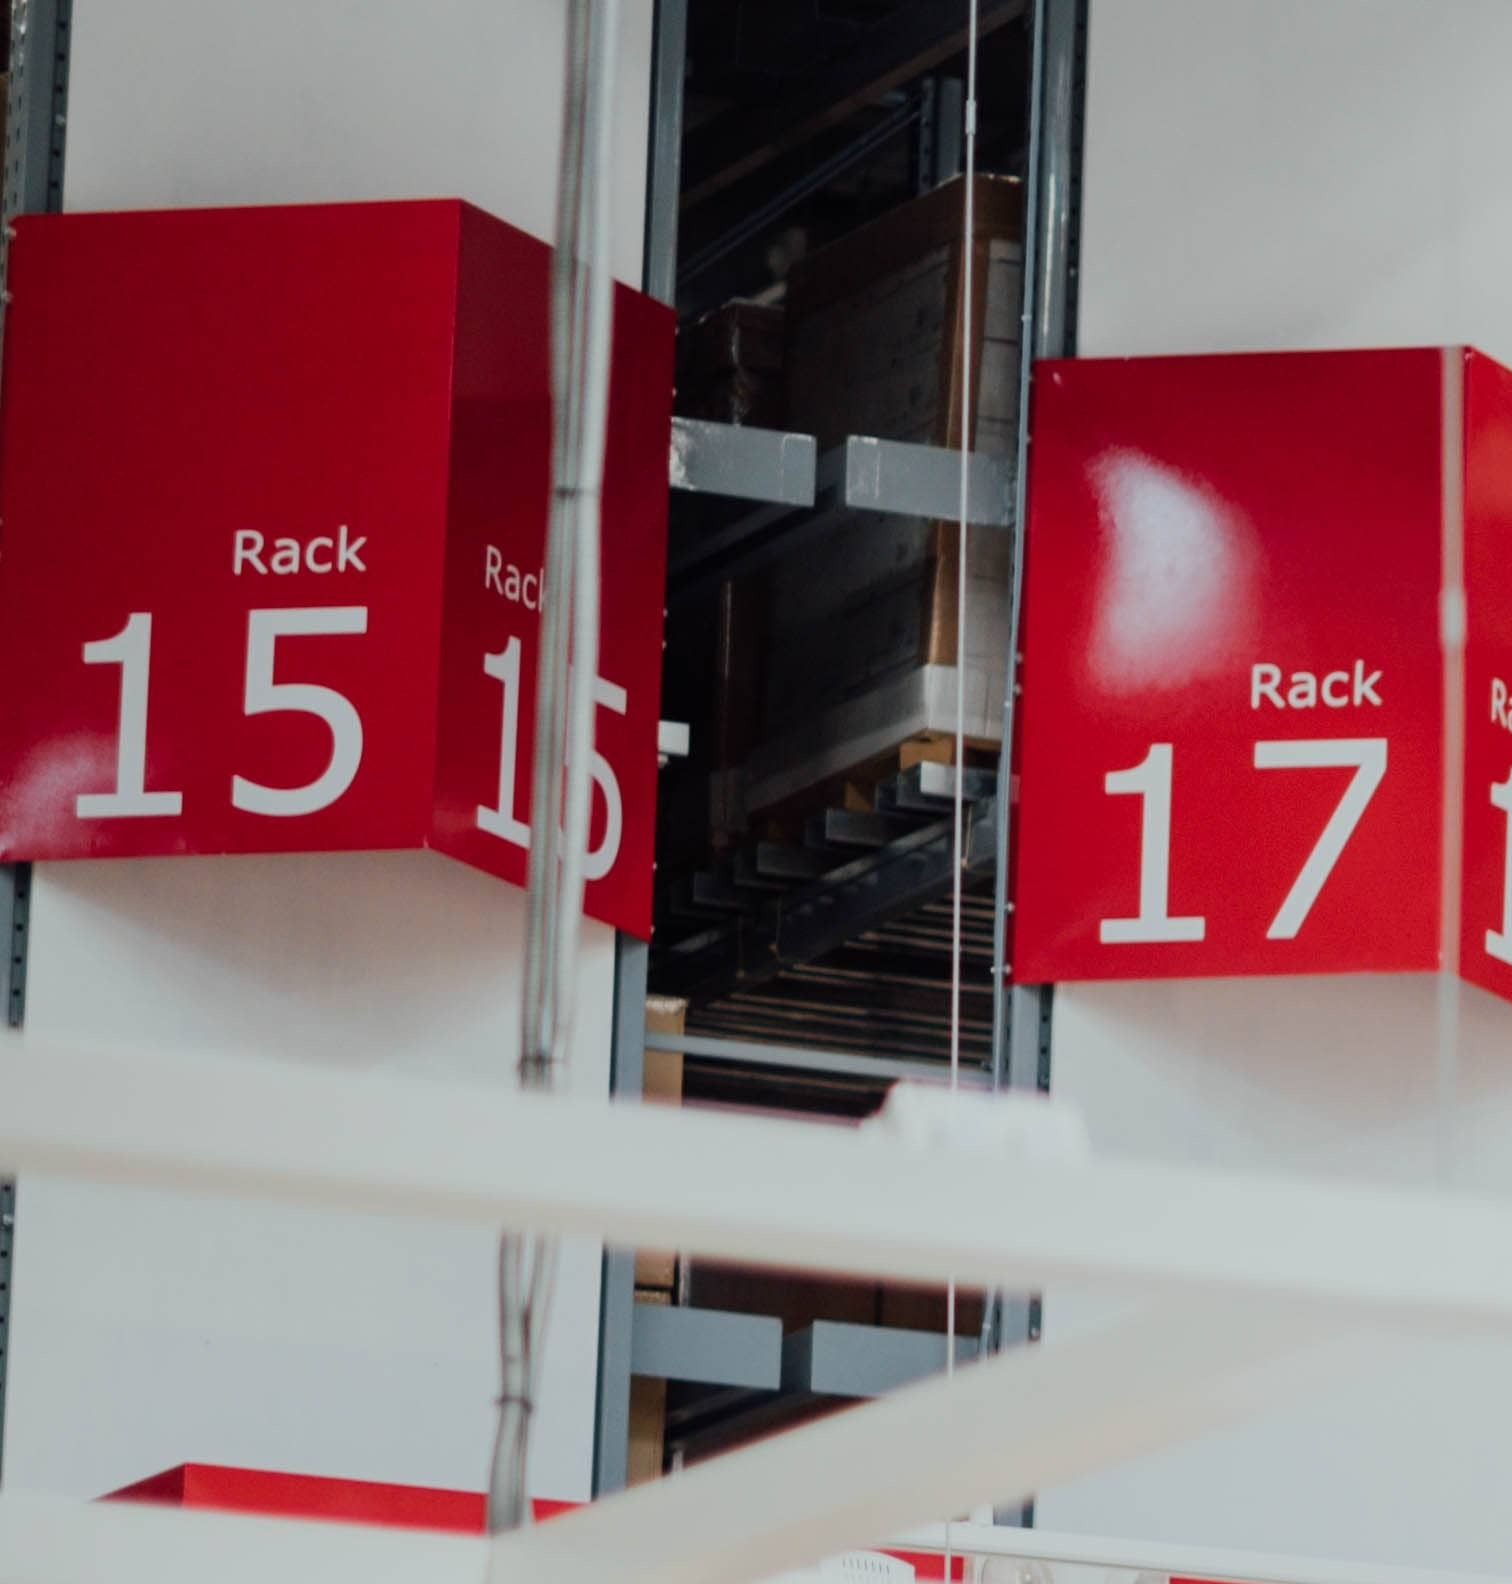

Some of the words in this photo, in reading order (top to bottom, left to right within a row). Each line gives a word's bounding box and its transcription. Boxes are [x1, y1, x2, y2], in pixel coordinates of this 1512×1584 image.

[231, 525, 368, 576] Rack
[483, 543, 546, 612] Rac
[75, 606, 369, 818] 15
[1251, 661, 1383, 709] Rack
[1100, 738, 1388, 944] 17
